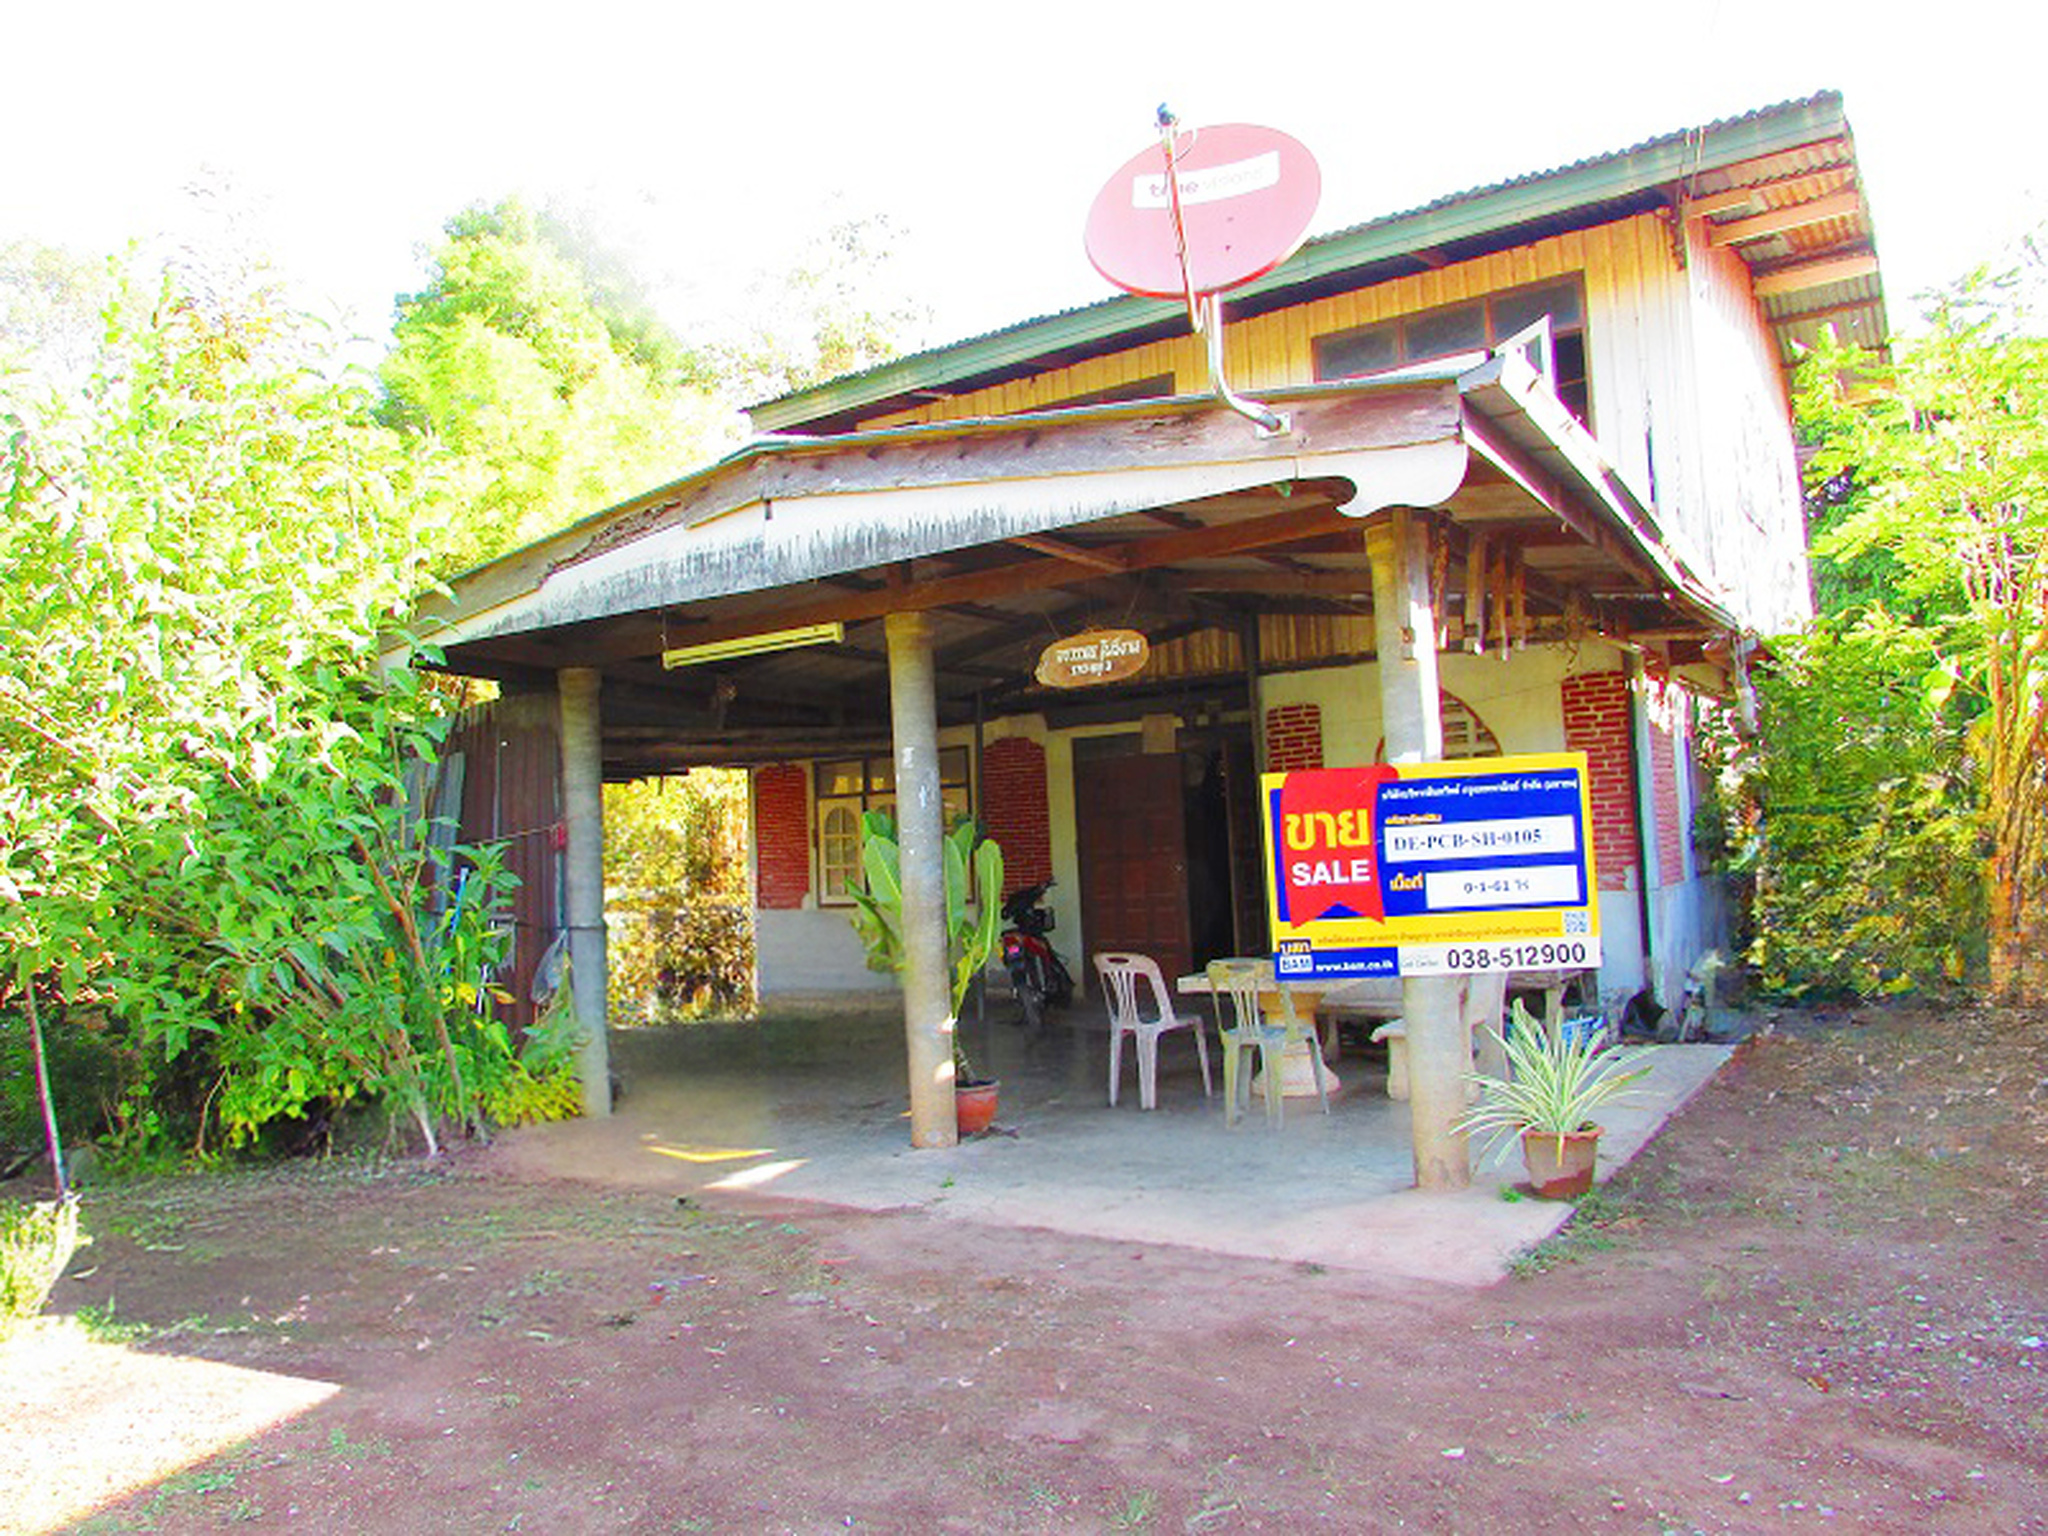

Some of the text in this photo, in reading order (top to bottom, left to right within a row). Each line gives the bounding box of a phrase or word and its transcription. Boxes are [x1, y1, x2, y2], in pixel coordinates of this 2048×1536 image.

[1285, 809, 1370, 851] ขาย
[1394, 828, 1543, 850] DE-PCB-SH-0105
[1292, 859, 1371, 886] SALE
[1282, 958, 1311, 970] BAM
[1447, 943, 1586, 970] 038-512900
